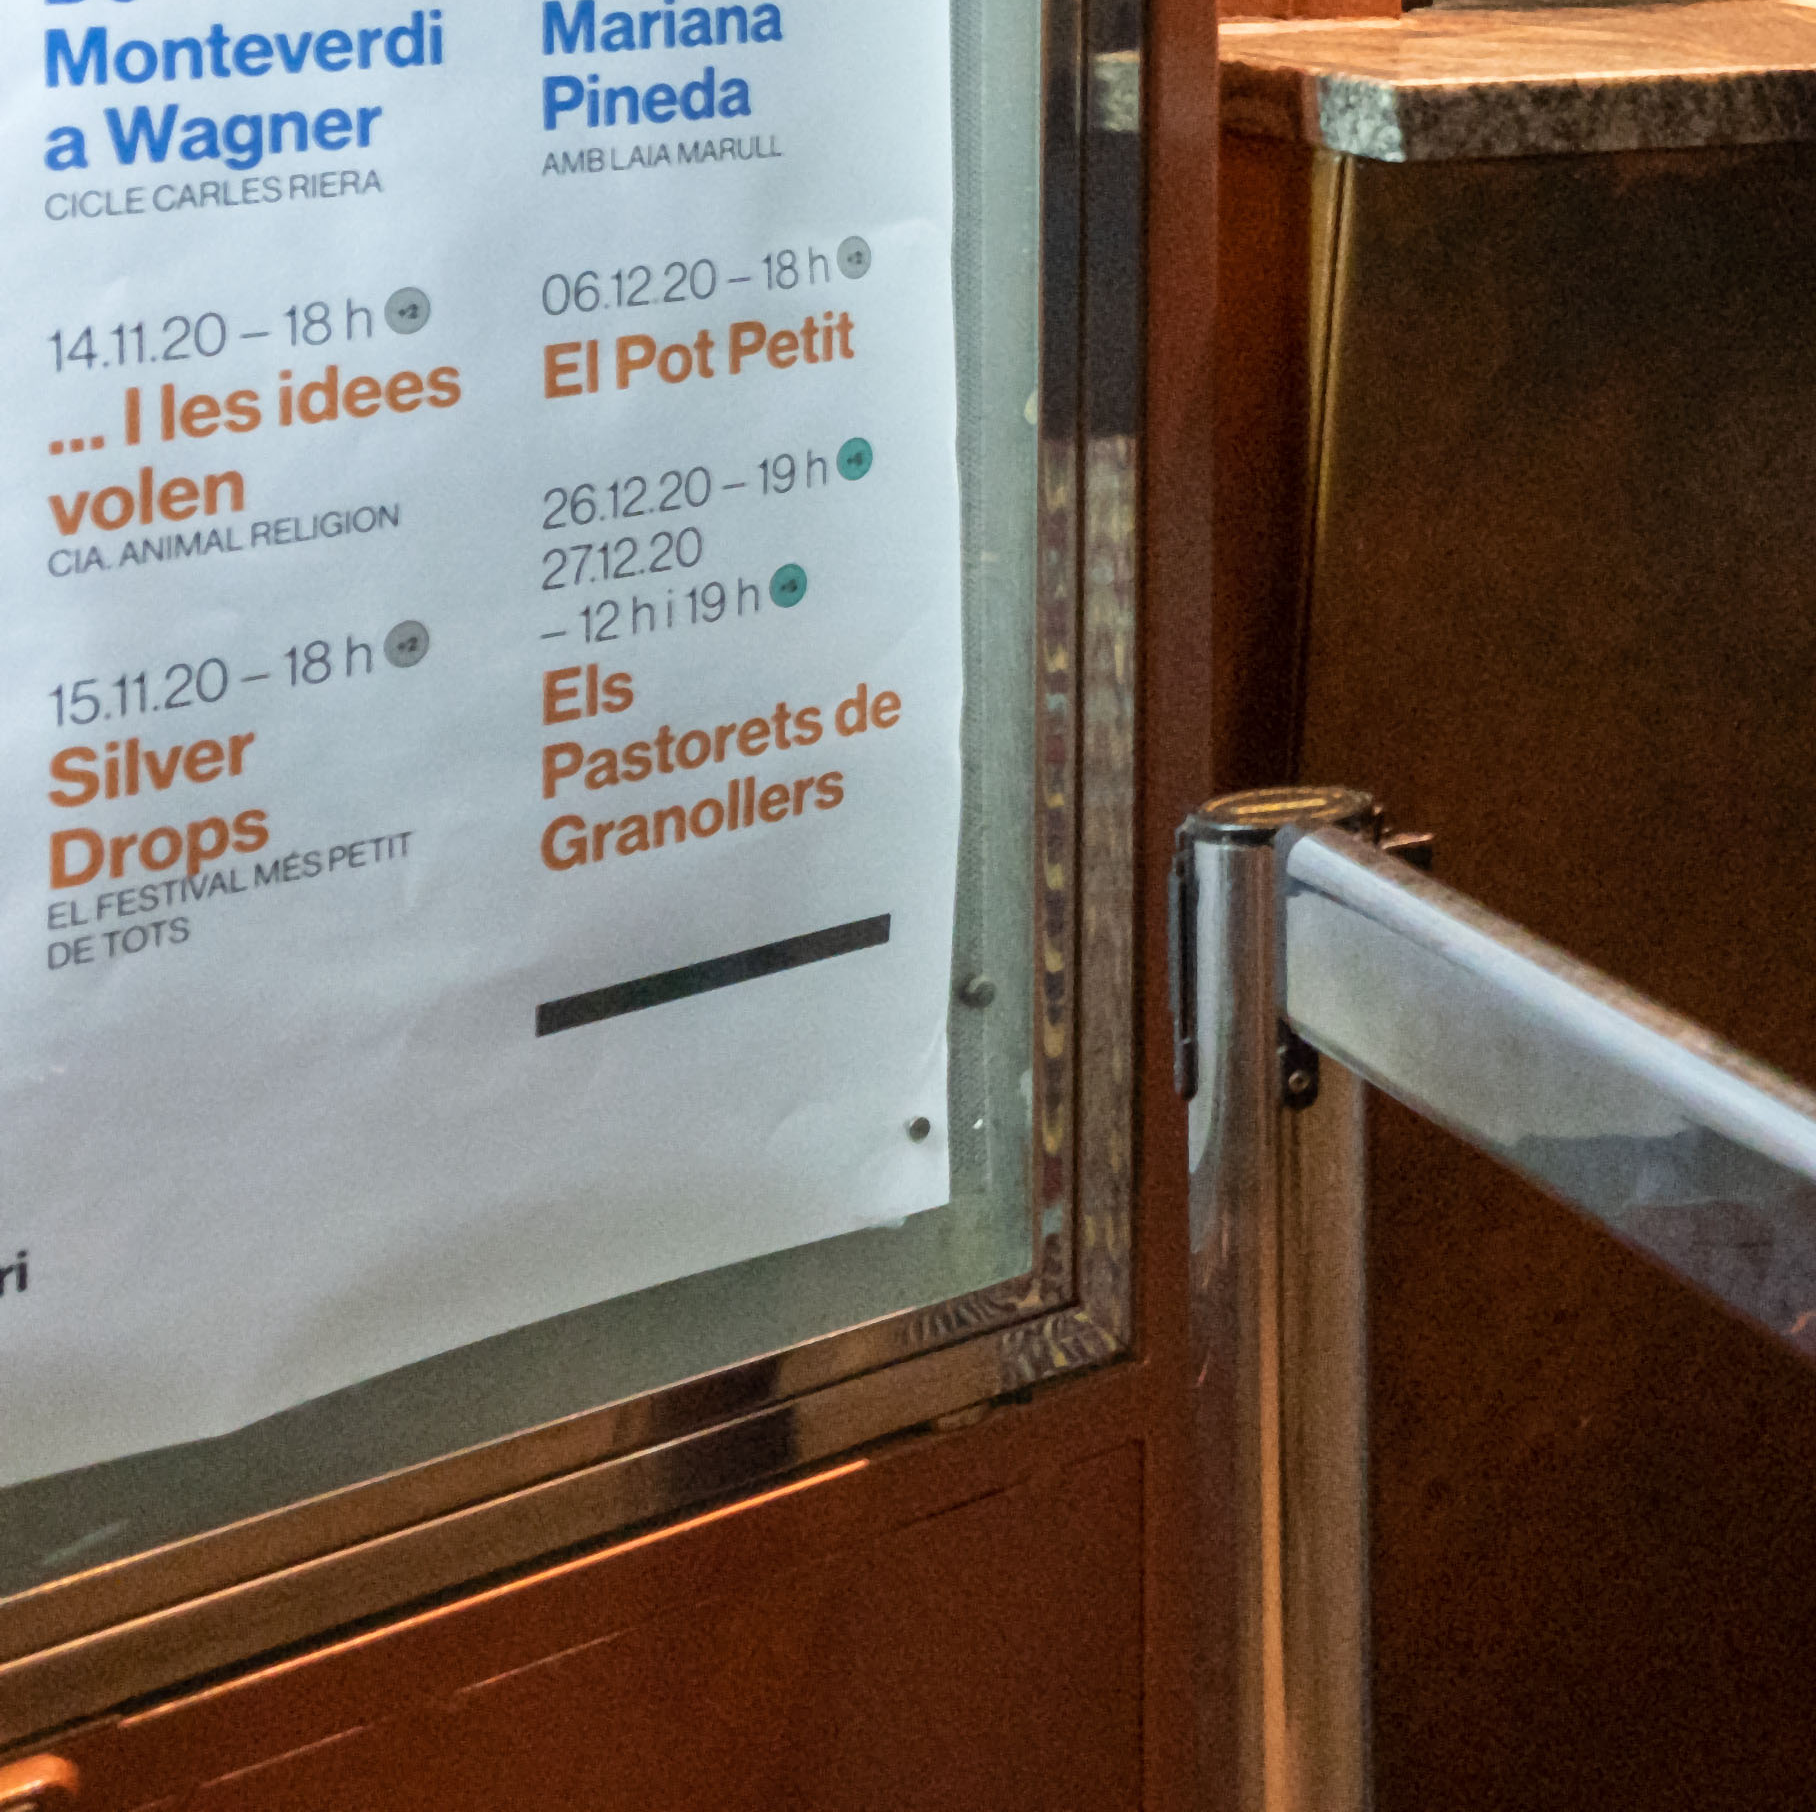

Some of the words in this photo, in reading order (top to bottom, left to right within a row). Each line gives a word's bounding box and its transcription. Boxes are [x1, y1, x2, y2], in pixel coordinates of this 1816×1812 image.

[43, 8, 445, 89] Monteverdi
[542, 65, 753, 132] Pineda
[43, 125, 91, 172] a
[103, 103, 384, 171] Wagner
[542, 148, 605, 176] AMB
[611, 143, 672, 171] LAIA
[678, 135, 784, 165] MARULL
[45, 186, 146, 221] CICLE
[152, 175, 283, 212] CARLES
[289, 169, 384, 200] RIERA
[542, 258, 718, 315] 06.12.20
[762, 249, 800, 290] 18
[47, 311, 227, 373] 14.11.20
[283, 300, 332, 347] 18
[544, 339, 599, 399] El
[616, 329, 715, 389] Pot
[729, 311, 855, 376] Petit
[161, 383, 262, 441] les
[279, 364, 461, 426] idees
[47, 466, 244, 536] volen
[542, 466, 712, 530] 26.12.20
[757, 453, 797, 495] 19
[47, 546, 113, 577] CIA.
[118, 527, 244, 568] ANIMAL
[251, 503, 401, 548] RELIGION
[541, 526, 704, 591] 27.12.20
[579, 599, 621, 644] 12
[685, 581, 728, 624] 19
[48, 657, 230, 727] 15.11.20
[284, 640, 334, 687] 18
[543, 663, 634, 725] Els
[48, 732, 256, 808] Silver
[542, 701, 824, 799] Pastorets
[834, 683, 901, 737] de
[49, 808, 271, 890] Drops
[540, 771, 844, 871] Granollers
[47, 900, 89, 931] EL
[97, 869, 248, 920] FESTIVAL
[328, 831, 413, 872] PETIT
[47, 935, 95, 971] DE
[101, 917, 191, 959] TOTS
